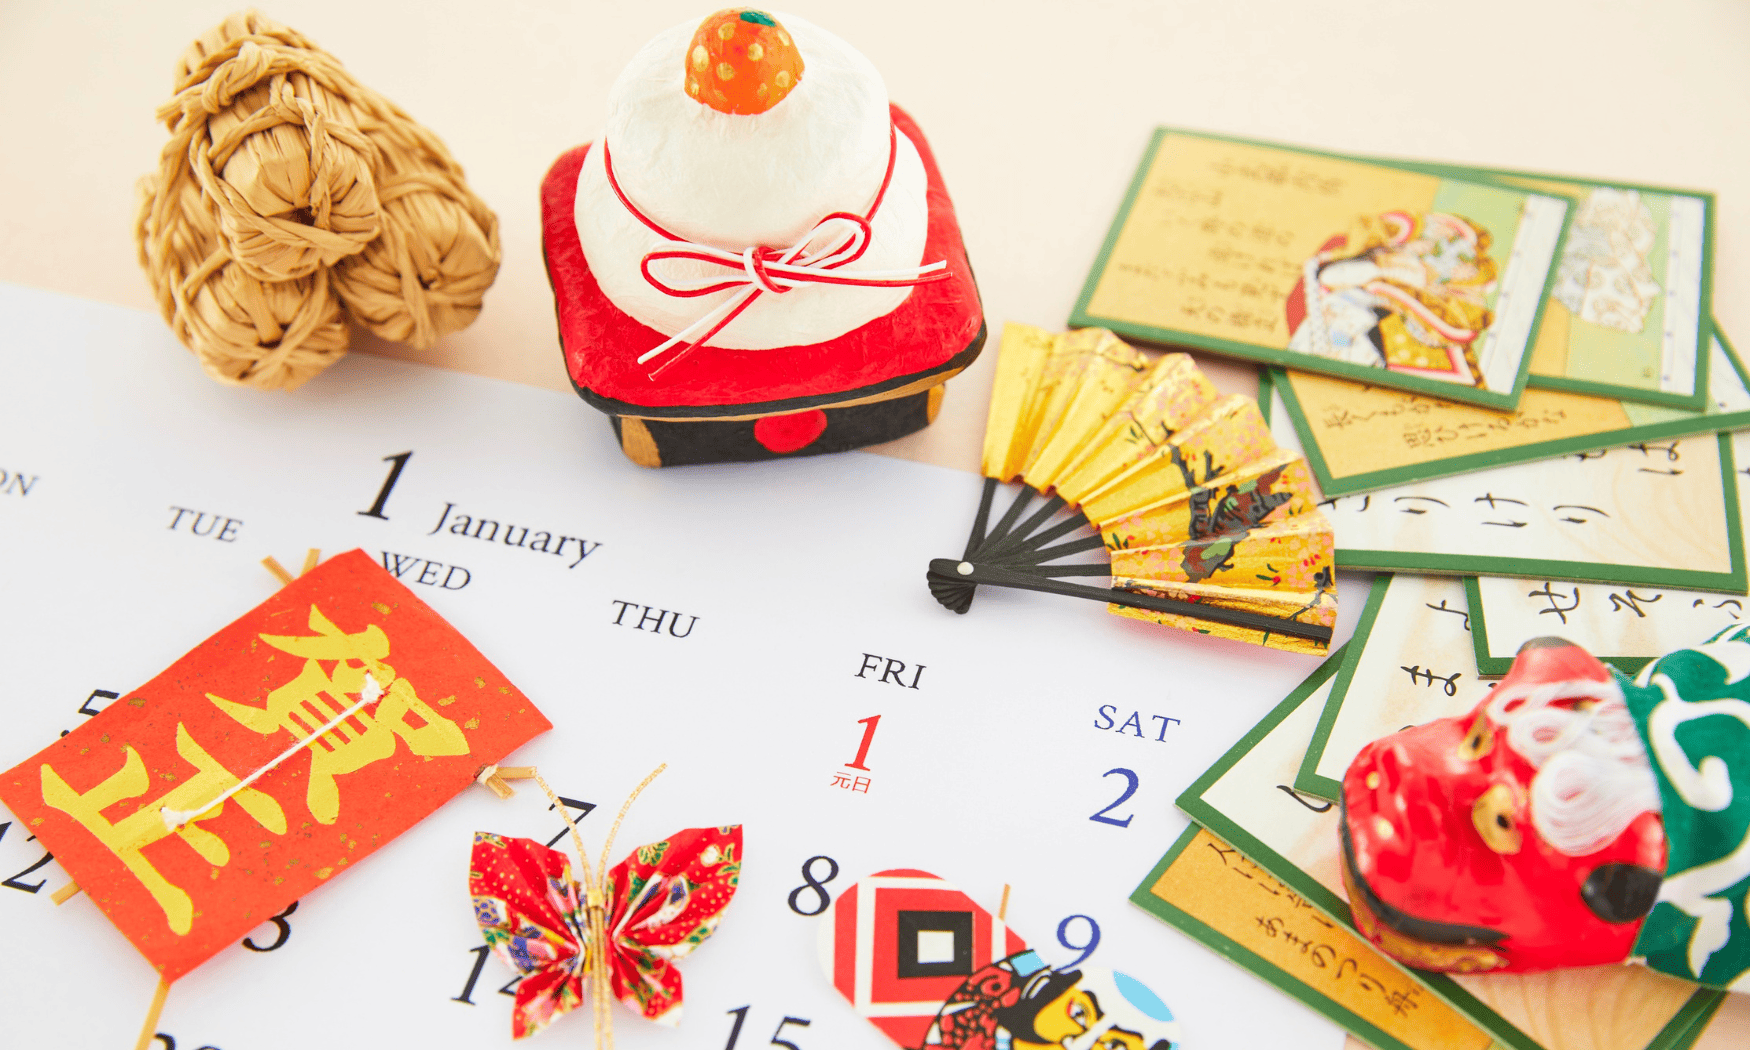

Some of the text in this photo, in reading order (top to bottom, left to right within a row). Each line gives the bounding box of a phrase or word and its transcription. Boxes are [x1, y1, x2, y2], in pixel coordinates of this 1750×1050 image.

[166, 506, 243, 543] TUE
[356, 450, 603, 569] 1 January
[381, 551, 472, 590] WED
[612, 600, 700, 638] THU
[854, 653, 927, 690] FRI
[844, 715, 882, 771] 1
[1094, 704, 1181, 743] SAT
[40, 603, 471, 937] 賀正
[830, 771, 872, 794] 元日
[1089, 767, 1139, 829] 2
[787, 855, 839, 917] 8
[1056, 914, 1101, 972] 9
